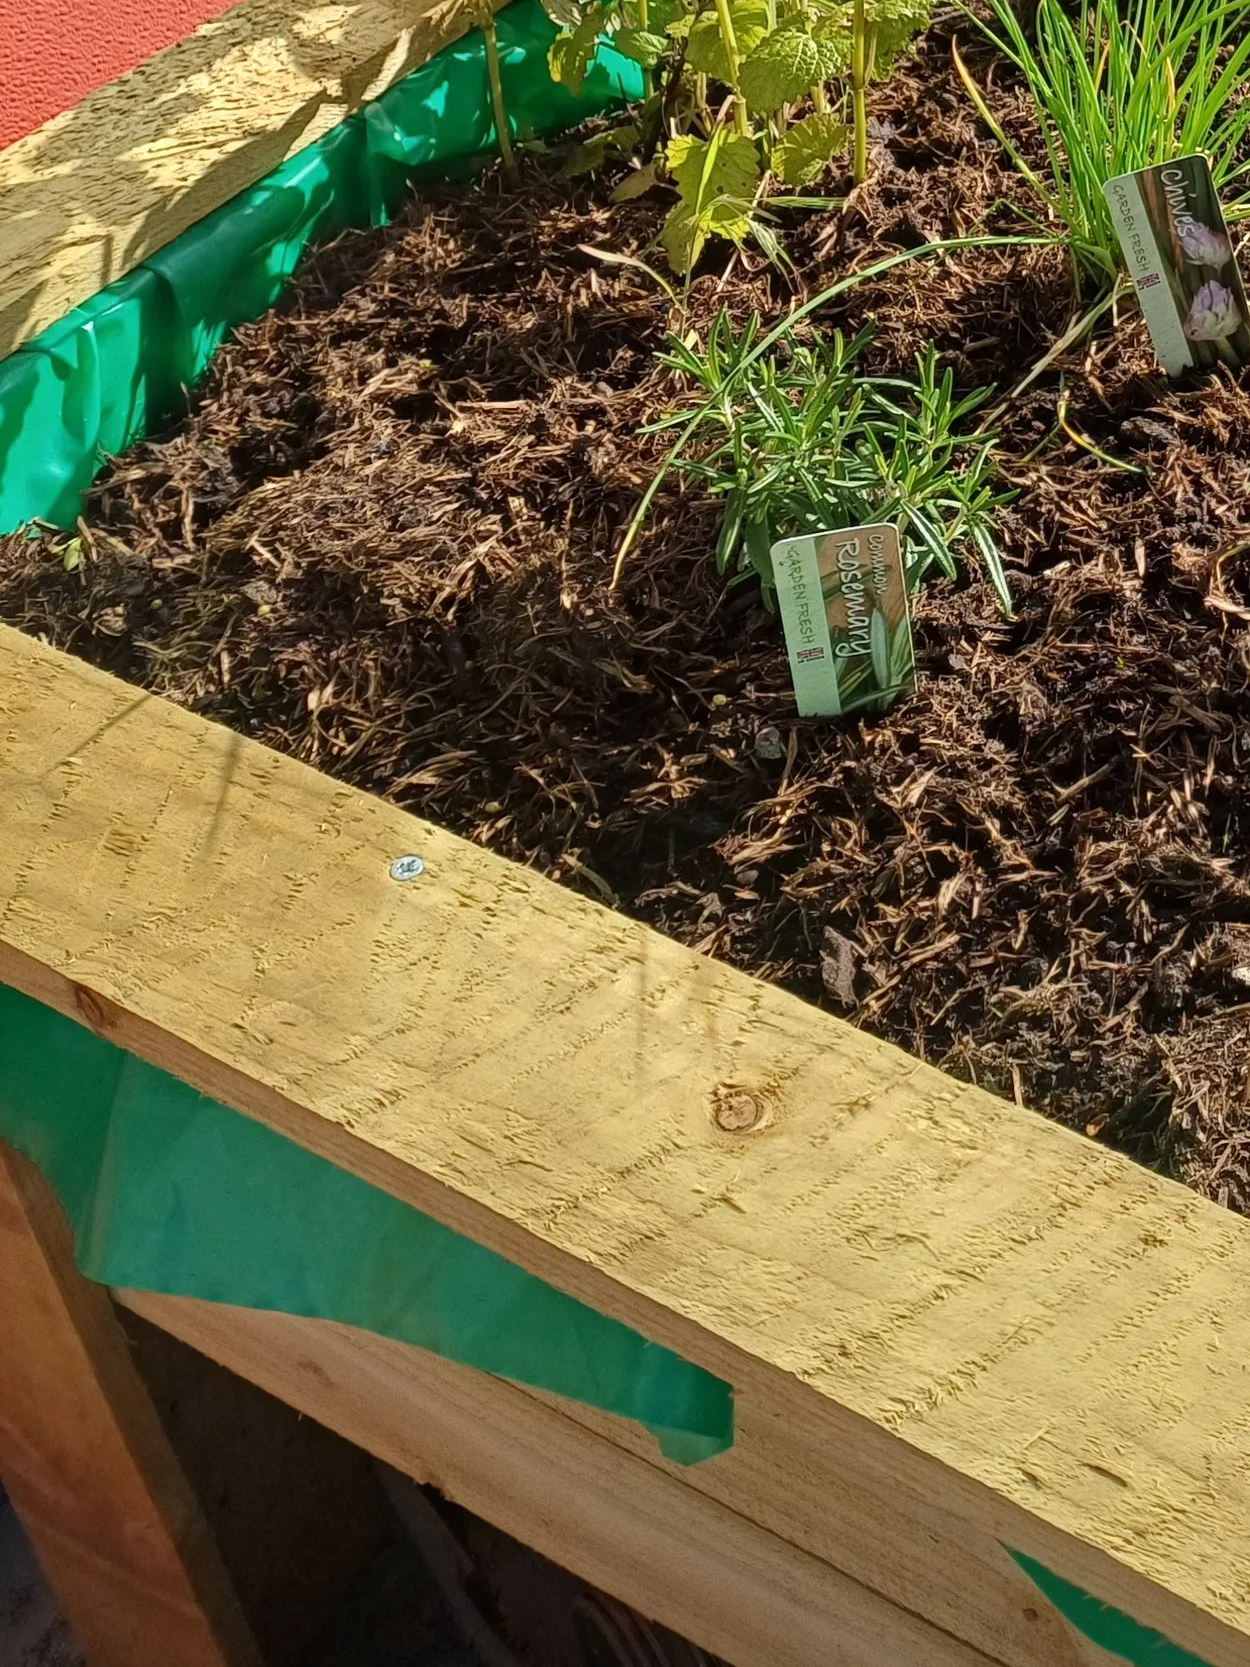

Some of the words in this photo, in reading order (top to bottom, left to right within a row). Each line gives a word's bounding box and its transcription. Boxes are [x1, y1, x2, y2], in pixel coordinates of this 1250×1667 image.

[1111, 184, 1135, 231] GARDEN
[1128, 233, 1150, 271] FRESH
[1160, 170, 1197, 238] Chives
[786, 548, 807, 600] GARDEN
[834, 538, 872, 657] Rosemary
[795, 602, 815, 645] FRESH
